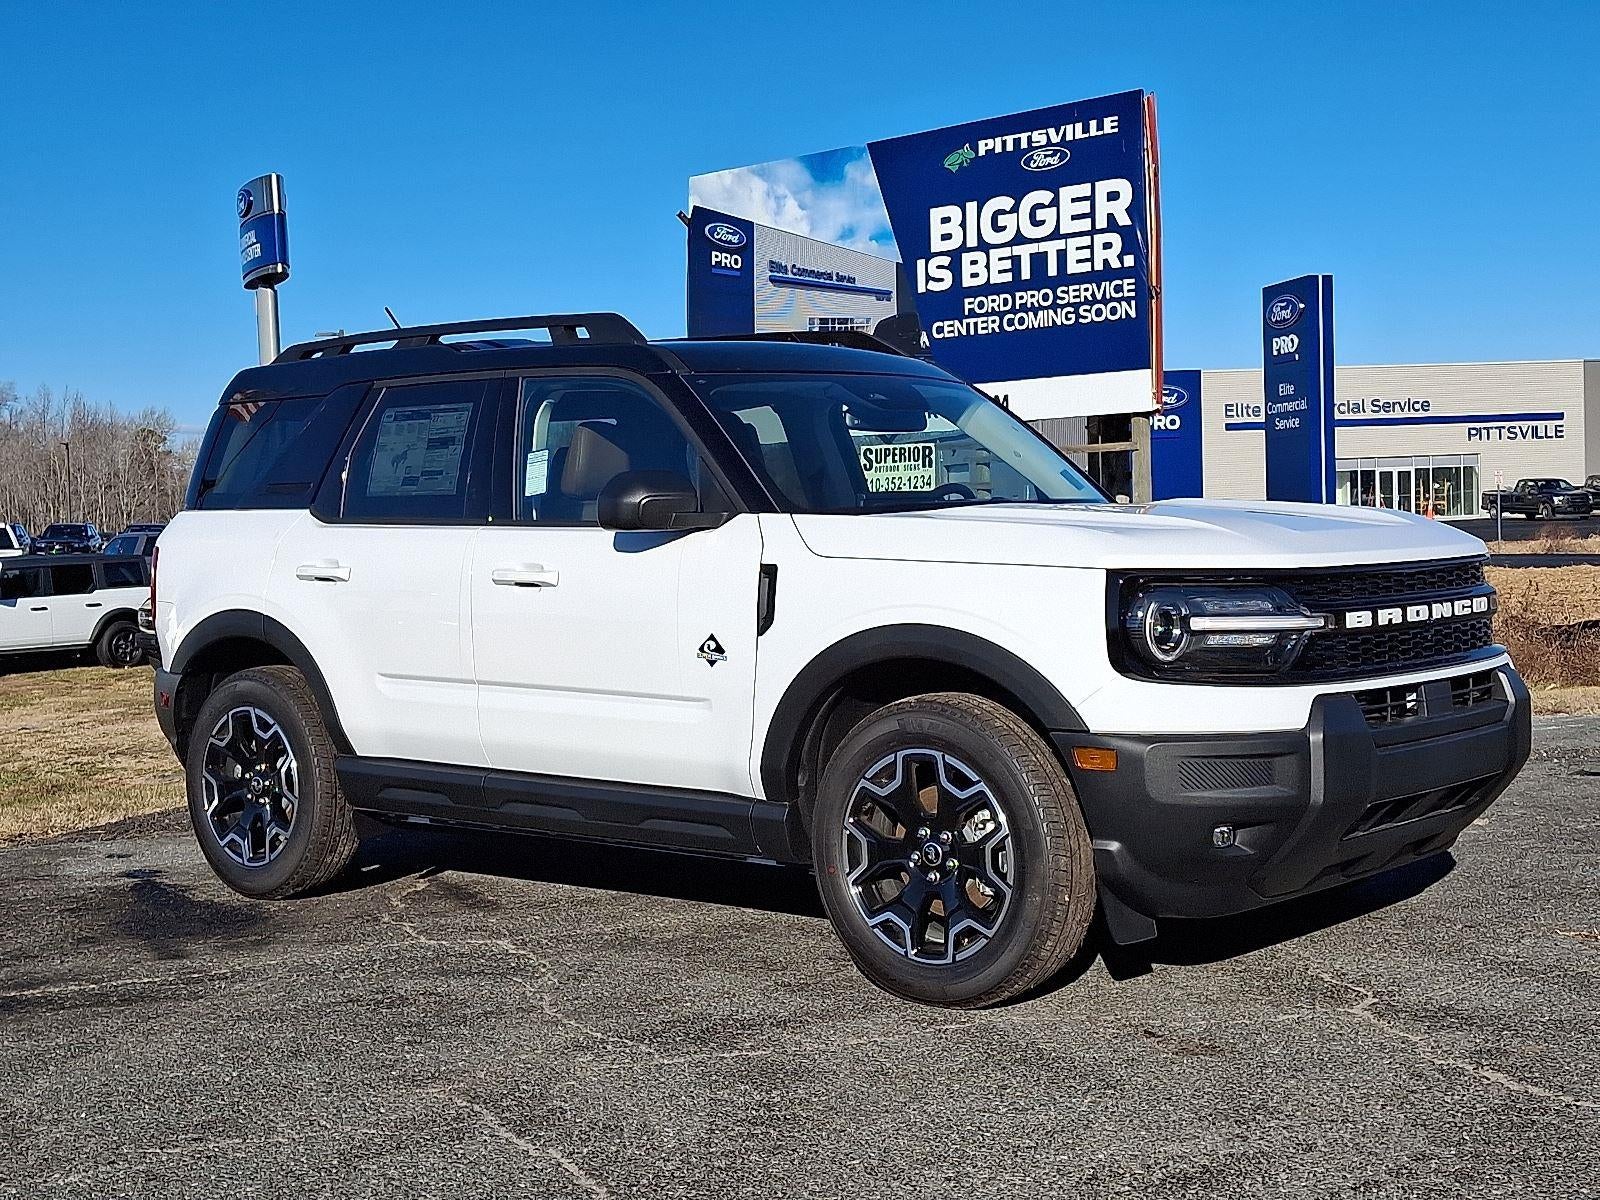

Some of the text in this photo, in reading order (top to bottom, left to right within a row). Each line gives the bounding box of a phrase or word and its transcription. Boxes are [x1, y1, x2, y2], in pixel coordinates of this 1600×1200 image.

[977, 116, 1119, 157] PITTSVILLE
[929, 178, 1133, 253] BIGGER
[711, 251, 741, 269] PRO
[916, 232, 1135, 294] IS BETTER.
[964, 278, 1135, 315] FORD PRO SERVICE
[931, 300, 1136, 339] CENTER COMING SOON
[1272, 333, 1298, 355] PRO
[1278, 383, 1294, 396] Elite
[1224, 403, 1261, 418] Elite
[1370, 397, 1430, 414] Service
[1266, 397, 1307, 414] Commercial
[1274, 416, 1300, 430] Service
[1467, 424, 1565, 441] PITTSVILLE
[862, 446, 933, 471] SUPERIOR
[874, 465, 899, 474] OUTDOOR
[903, 463, 921, 472] SIGNS
[865, 474, 931, 491] 10-352-1234
[1345, 597, 1487, 628] BRONCO
